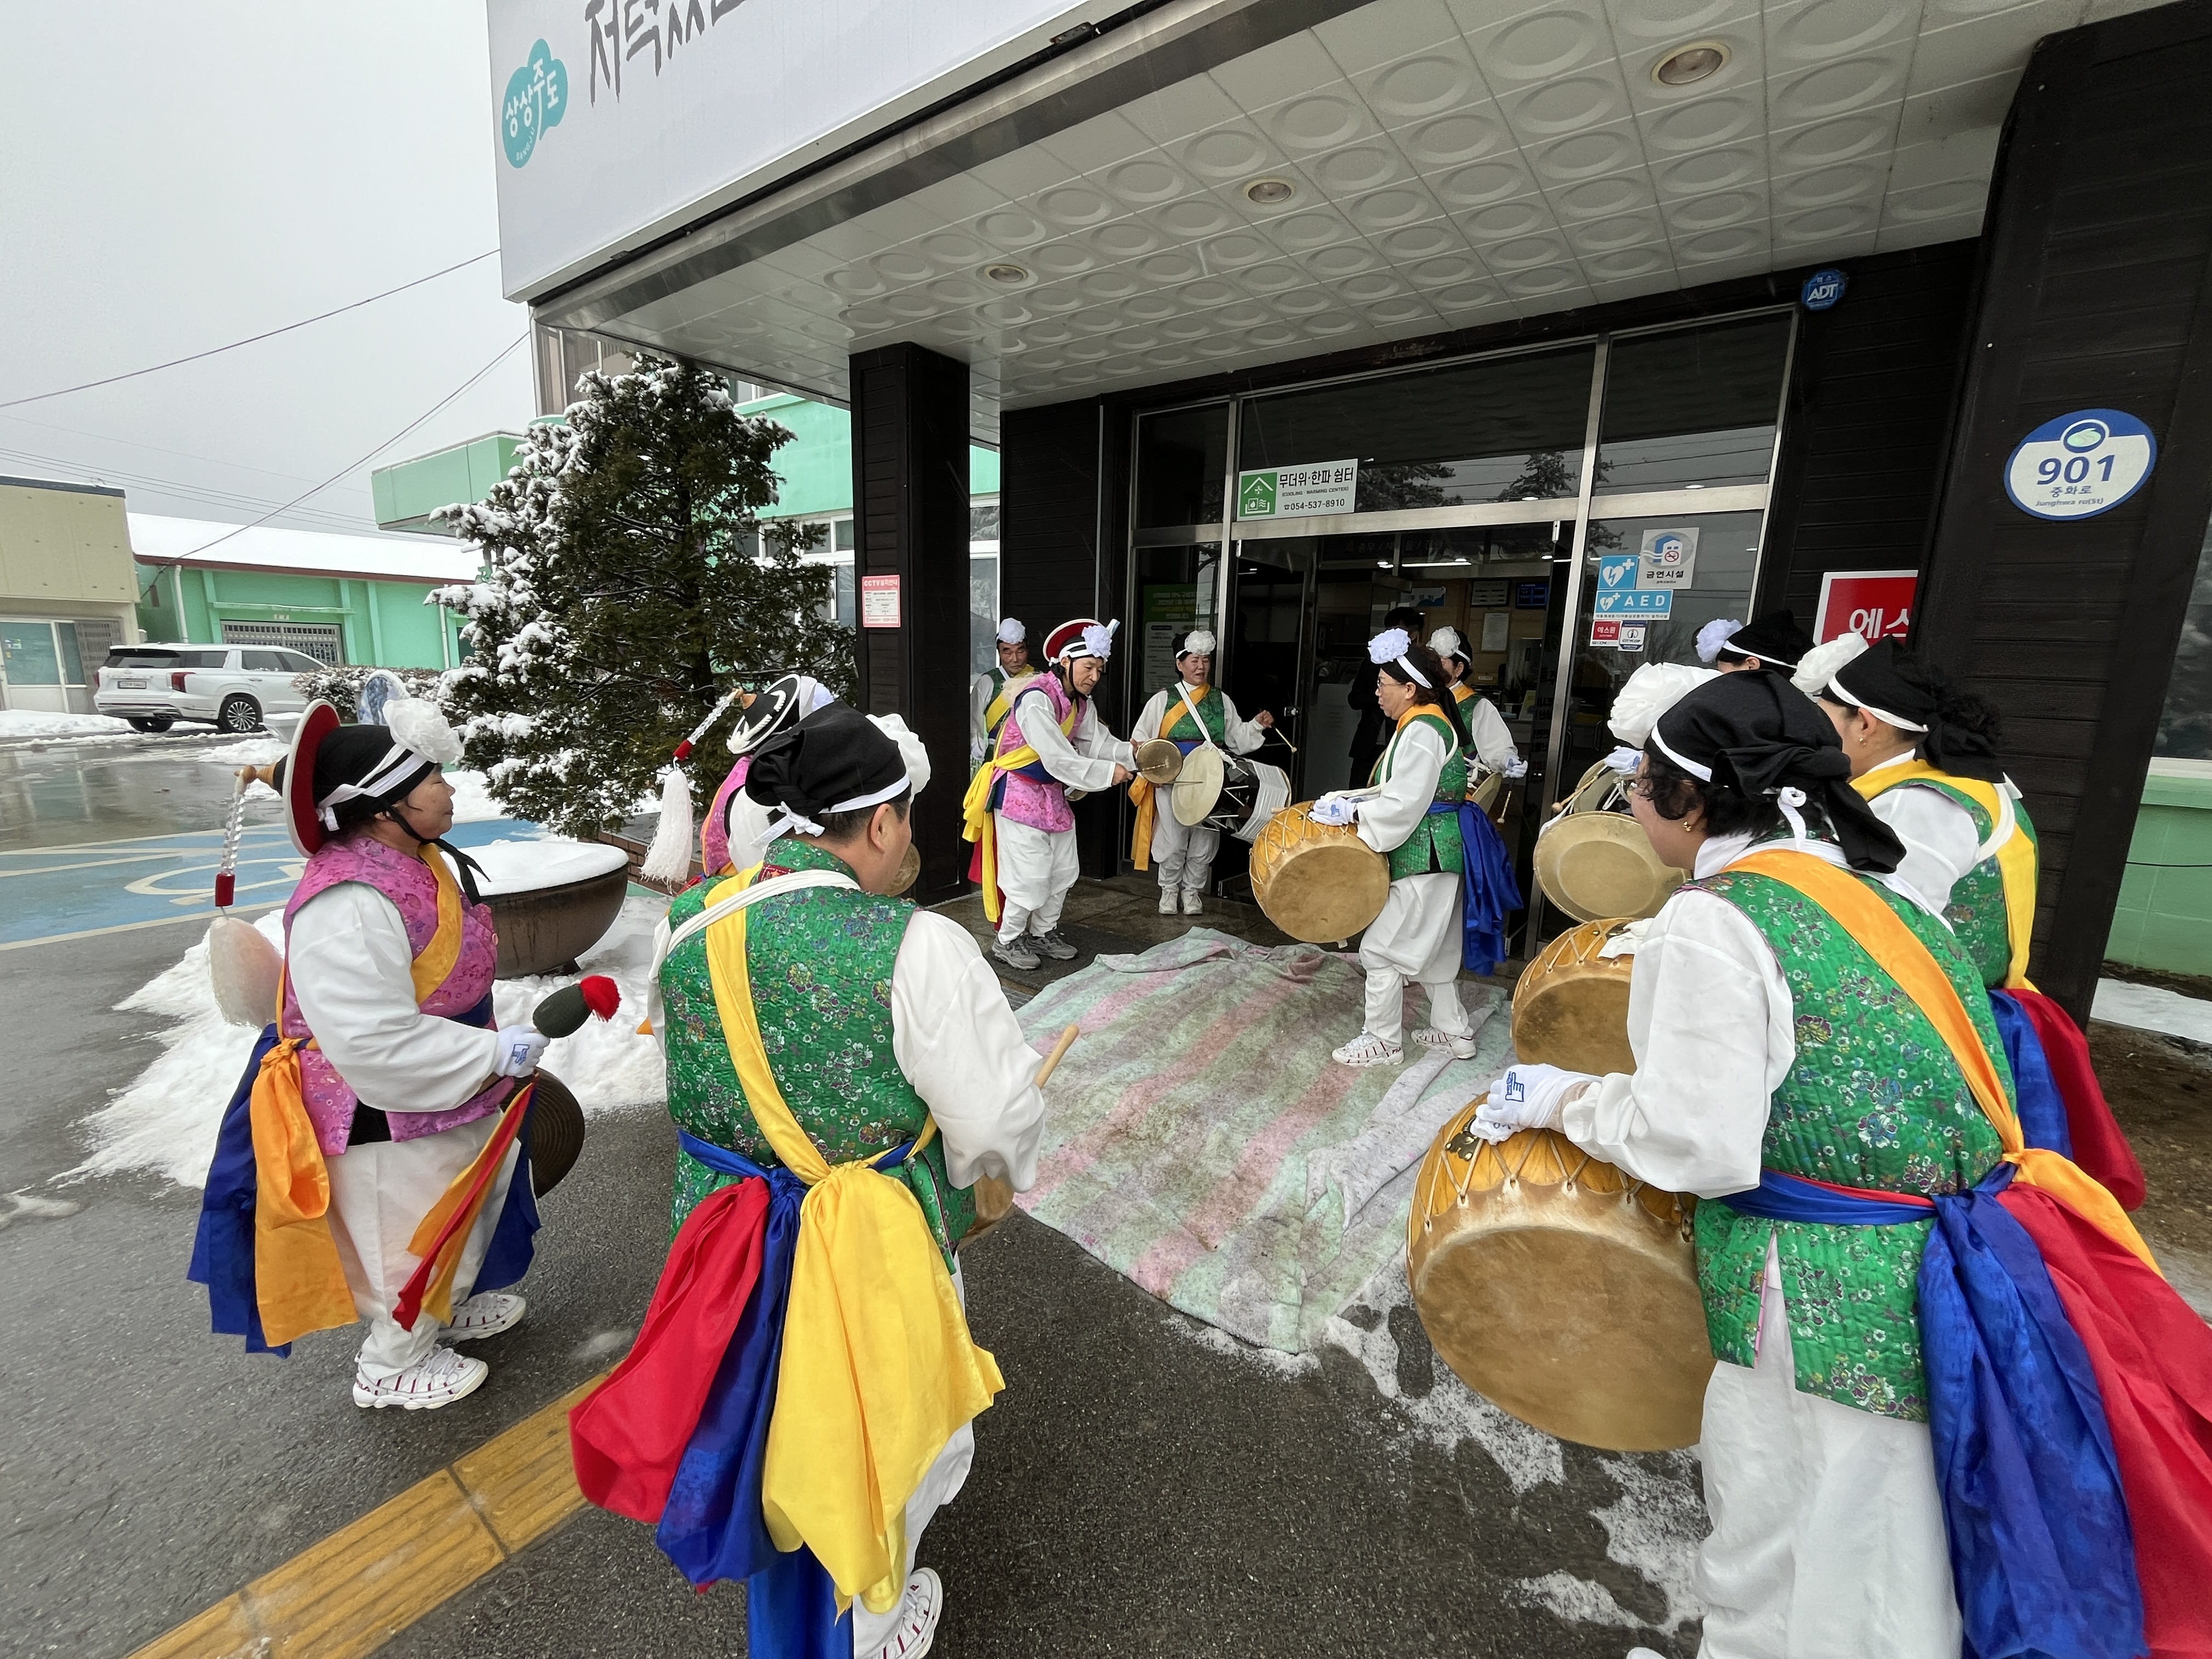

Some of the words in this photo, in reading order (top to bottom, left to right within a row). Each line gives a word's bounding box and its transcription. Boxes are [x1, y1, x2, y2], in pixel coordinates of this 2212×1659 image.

[516, 127, 535, 161] SANGJU
[1808, 283, 1839, 301] ADT
[1279, 469, 1331, 488] 무더위·한파
[1334, 466, 1354, 483] 쉼터
[2036, 454, 2115, 485] 901
[2050, 485, 2092, 498] 중화로
[1290, 498, 1345, 510] 054-537-8910
[2035, 499, 2075, 507] Junghwa
[2078, 497, 2103, 505] ro(St)
[1646, 570, 1684, 579] 금연시설
